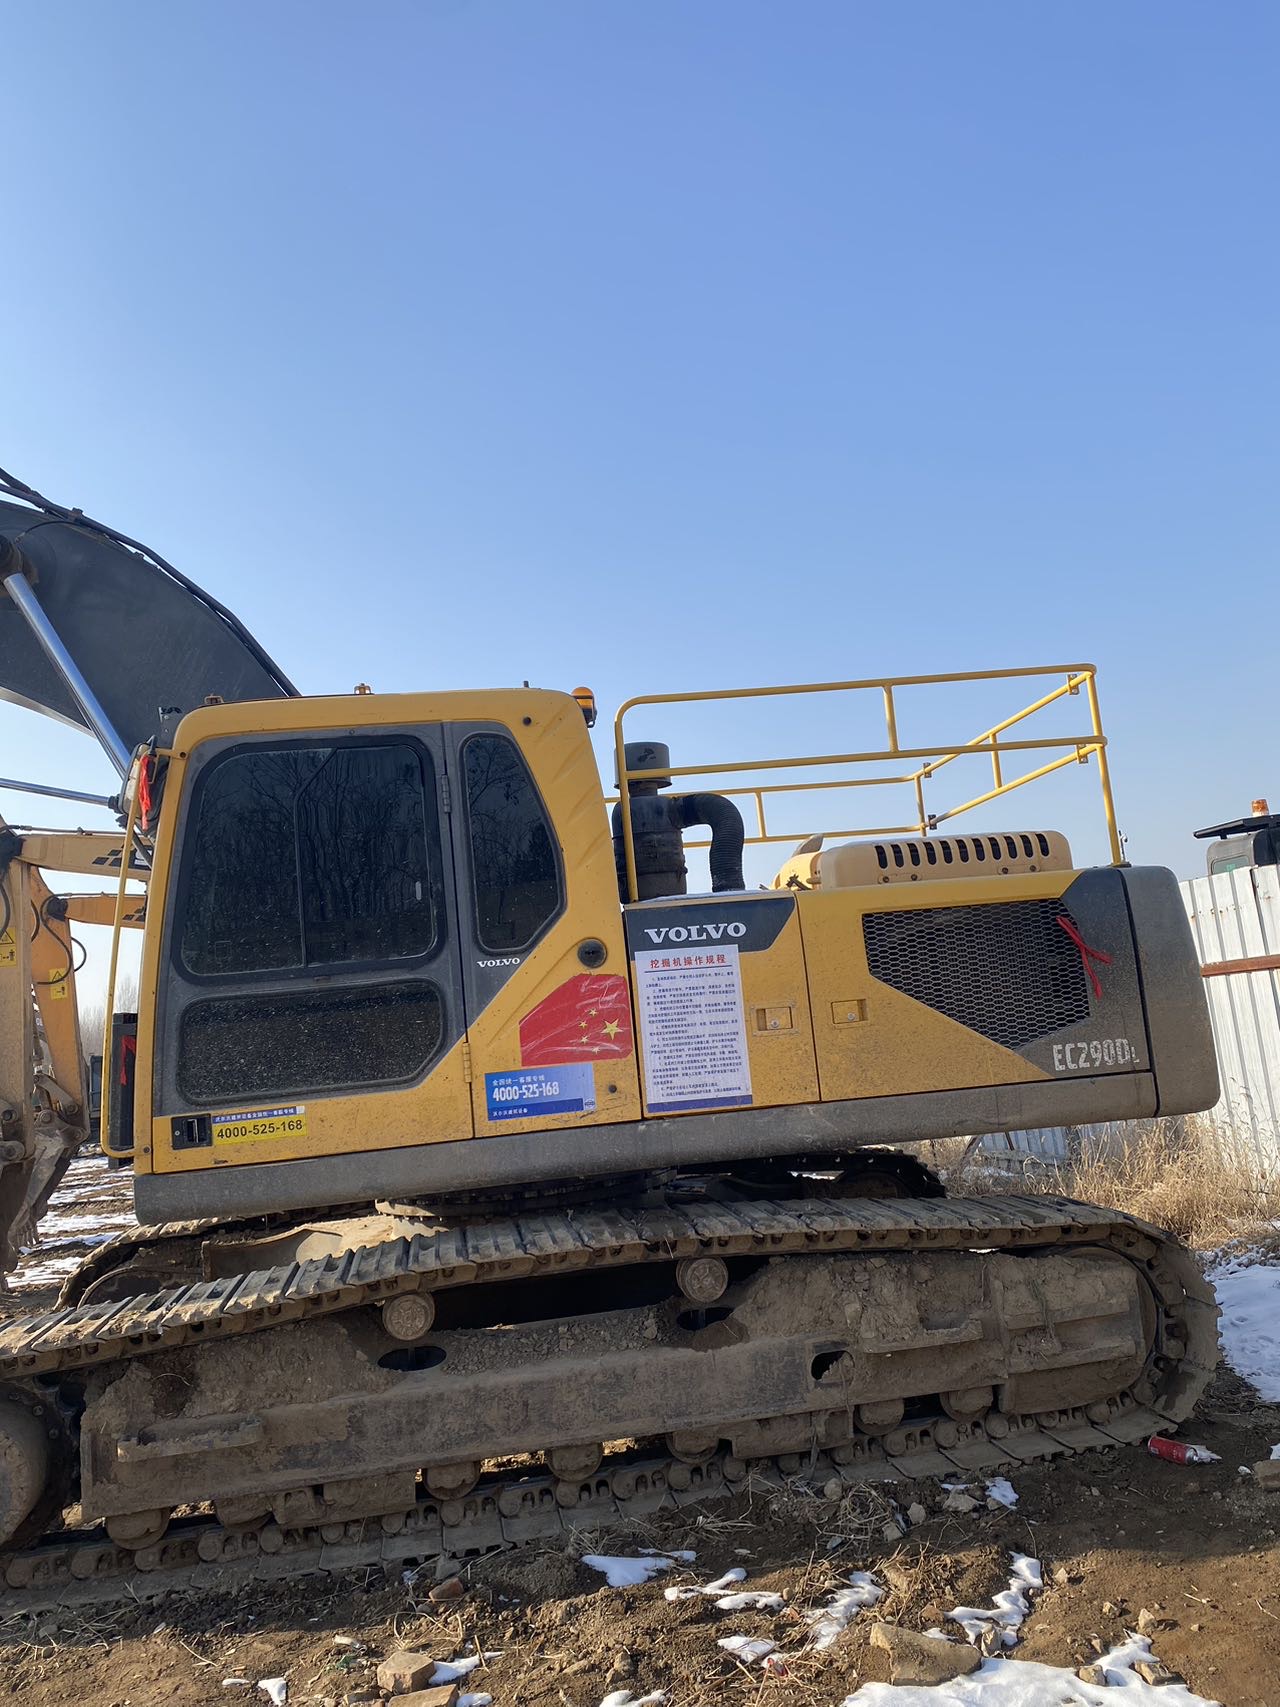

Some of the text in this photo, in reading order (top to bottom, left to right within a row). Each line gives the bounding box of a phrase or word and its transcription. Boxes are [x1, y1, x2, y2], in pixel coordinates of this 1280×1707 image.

[644, 922, 747, 944] VOLVO
[476, 957, 521, 968] VOLVO
[650, 954, 727, 969] 挖掘机操作规程
[492, 1081, 560, 1101] 4000-525-168
[217, 1119, 303, 1139] 4000-525-168
